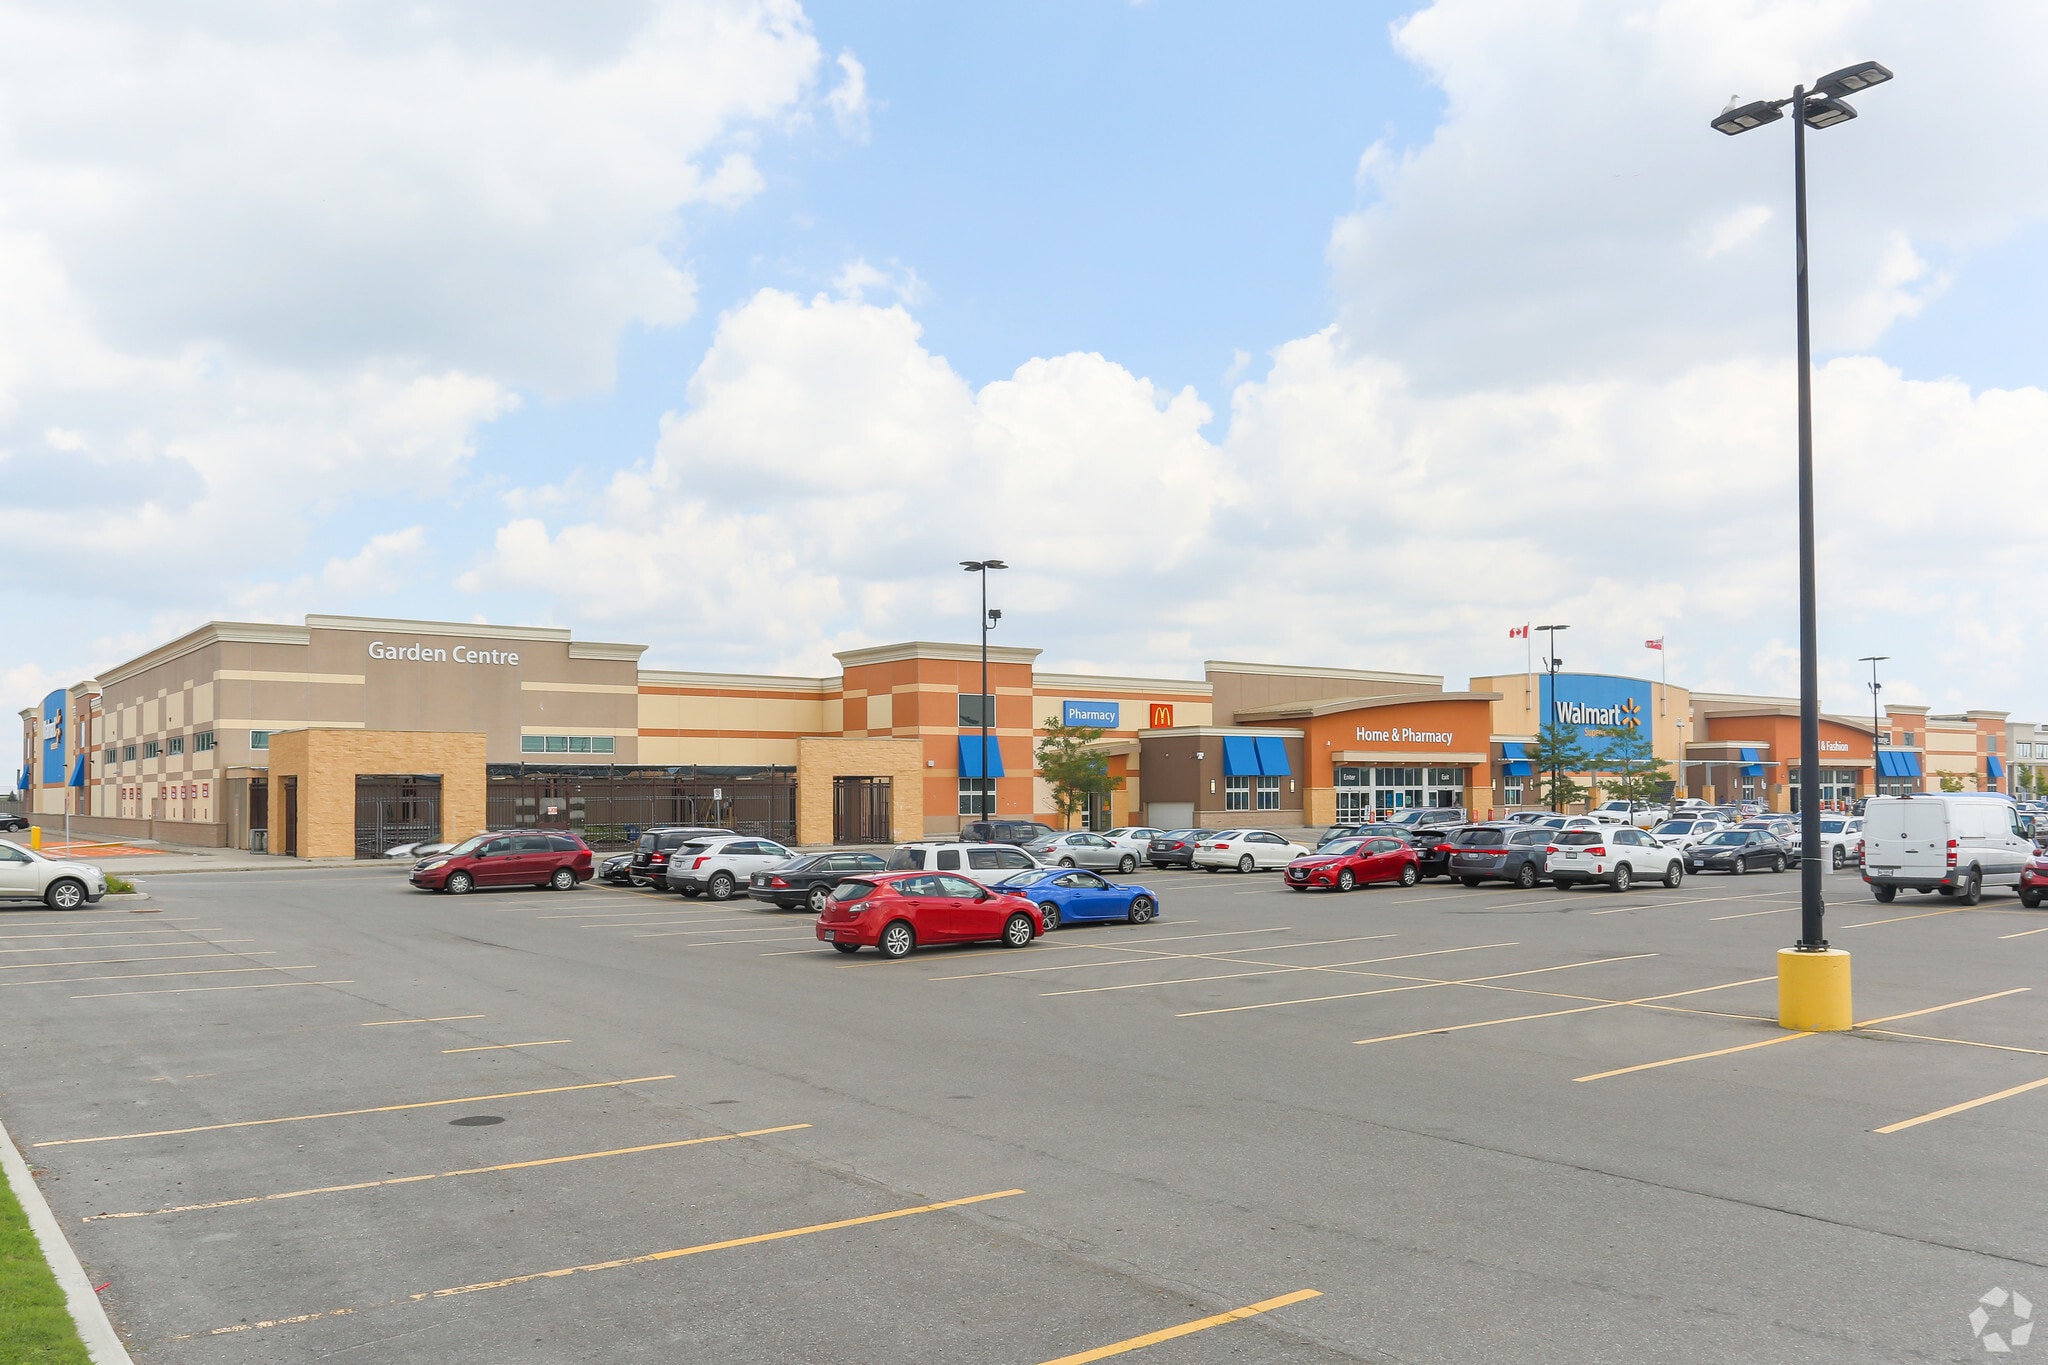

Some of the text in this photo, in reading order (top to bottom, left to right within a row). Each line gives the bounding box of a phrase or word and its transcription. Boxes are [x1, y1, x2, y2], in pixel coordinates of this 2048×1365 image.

[368, 641, 519, 666] Garden Centre
[1069, 708, 1116, 723] Pharmacy
[1555, 701, 1620, 726] Walmart
[1356, 727, 1453, 746] Home & Pharmacy
[1826, 741, 1848, 752] Fashion
[1343, 773, 1356, 781] Enter
